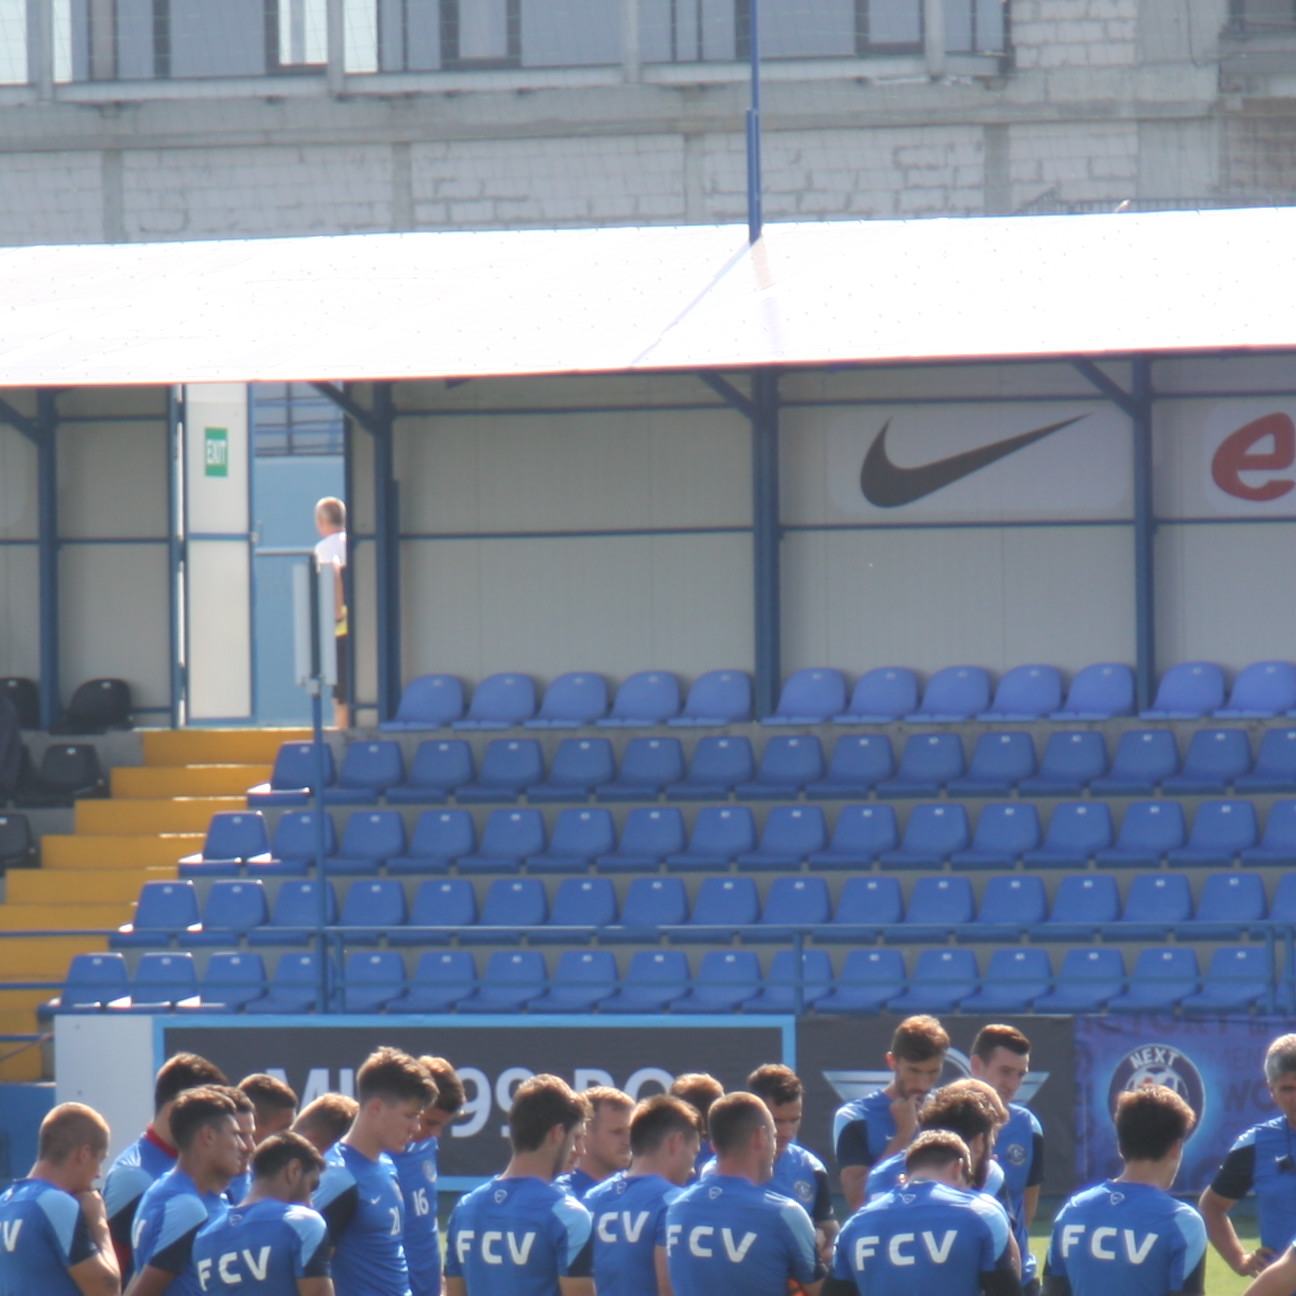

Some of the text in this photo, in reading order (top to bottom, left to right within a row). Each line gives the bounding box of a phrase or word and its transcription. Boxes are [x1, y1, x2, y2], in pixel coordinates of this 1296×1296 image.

[206, 438, 227, 464] EXIT
[1129, 1048, 1178, 1068] NEXT
[412, 1187, 430, 1217] 16
[590, 1210, 650, 1243] CV
[667, 1224, 758, 1263] FCV
[1062, 1224, 1159, 1265] FCV
[456, 1229, 536, 1266] FCV
[855, 1229, 958, 1272] FCV
[197, 1245, 272, 1292] FCV
